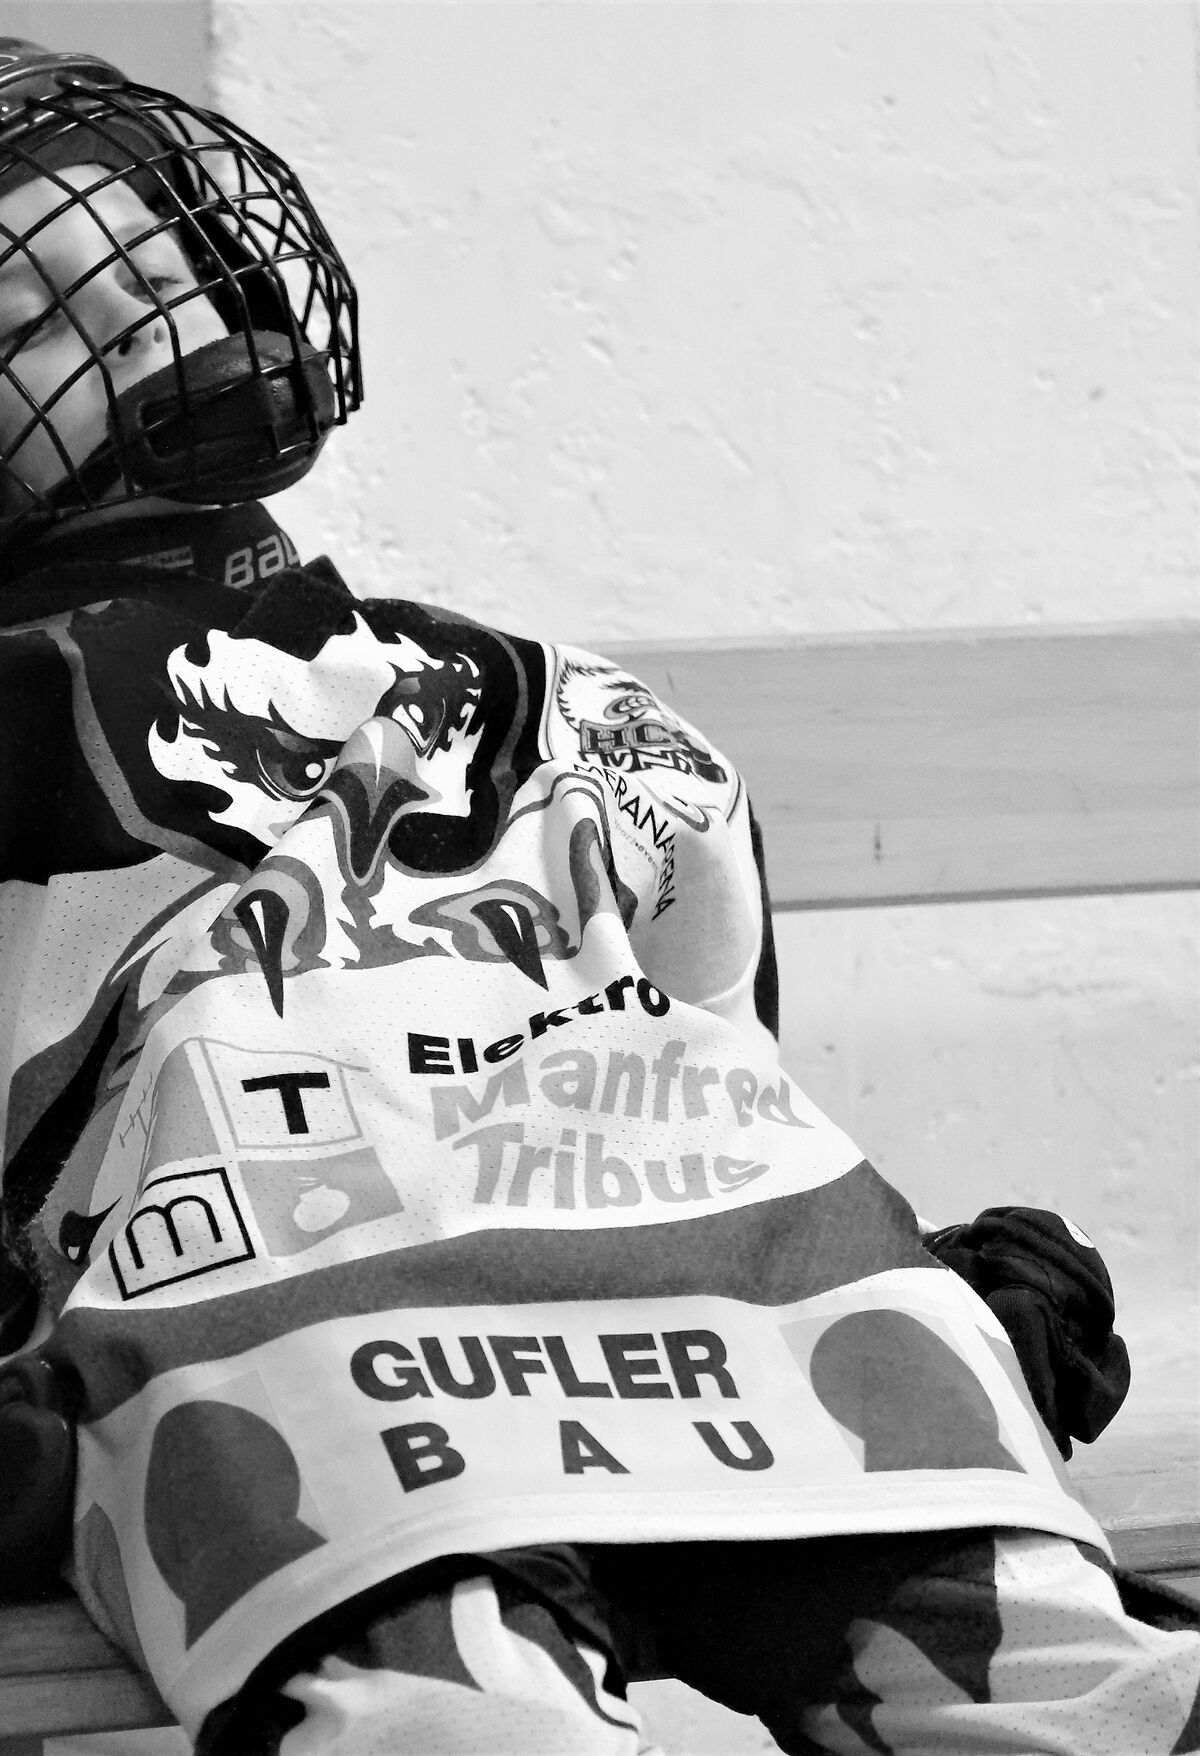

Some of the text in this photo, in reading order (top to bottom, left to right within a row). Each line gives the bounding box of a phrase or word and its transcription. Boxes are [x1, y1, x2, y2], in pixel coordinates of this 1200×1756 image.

[407, 975, 671, 1075] Elektro
[241, 1071, 331, 1135] T
[430, 1039, 815, 1142] Manfred
[452, 1121, 770, 1210] Tribus
[349, 1328, 741, 1403] GUFLER
